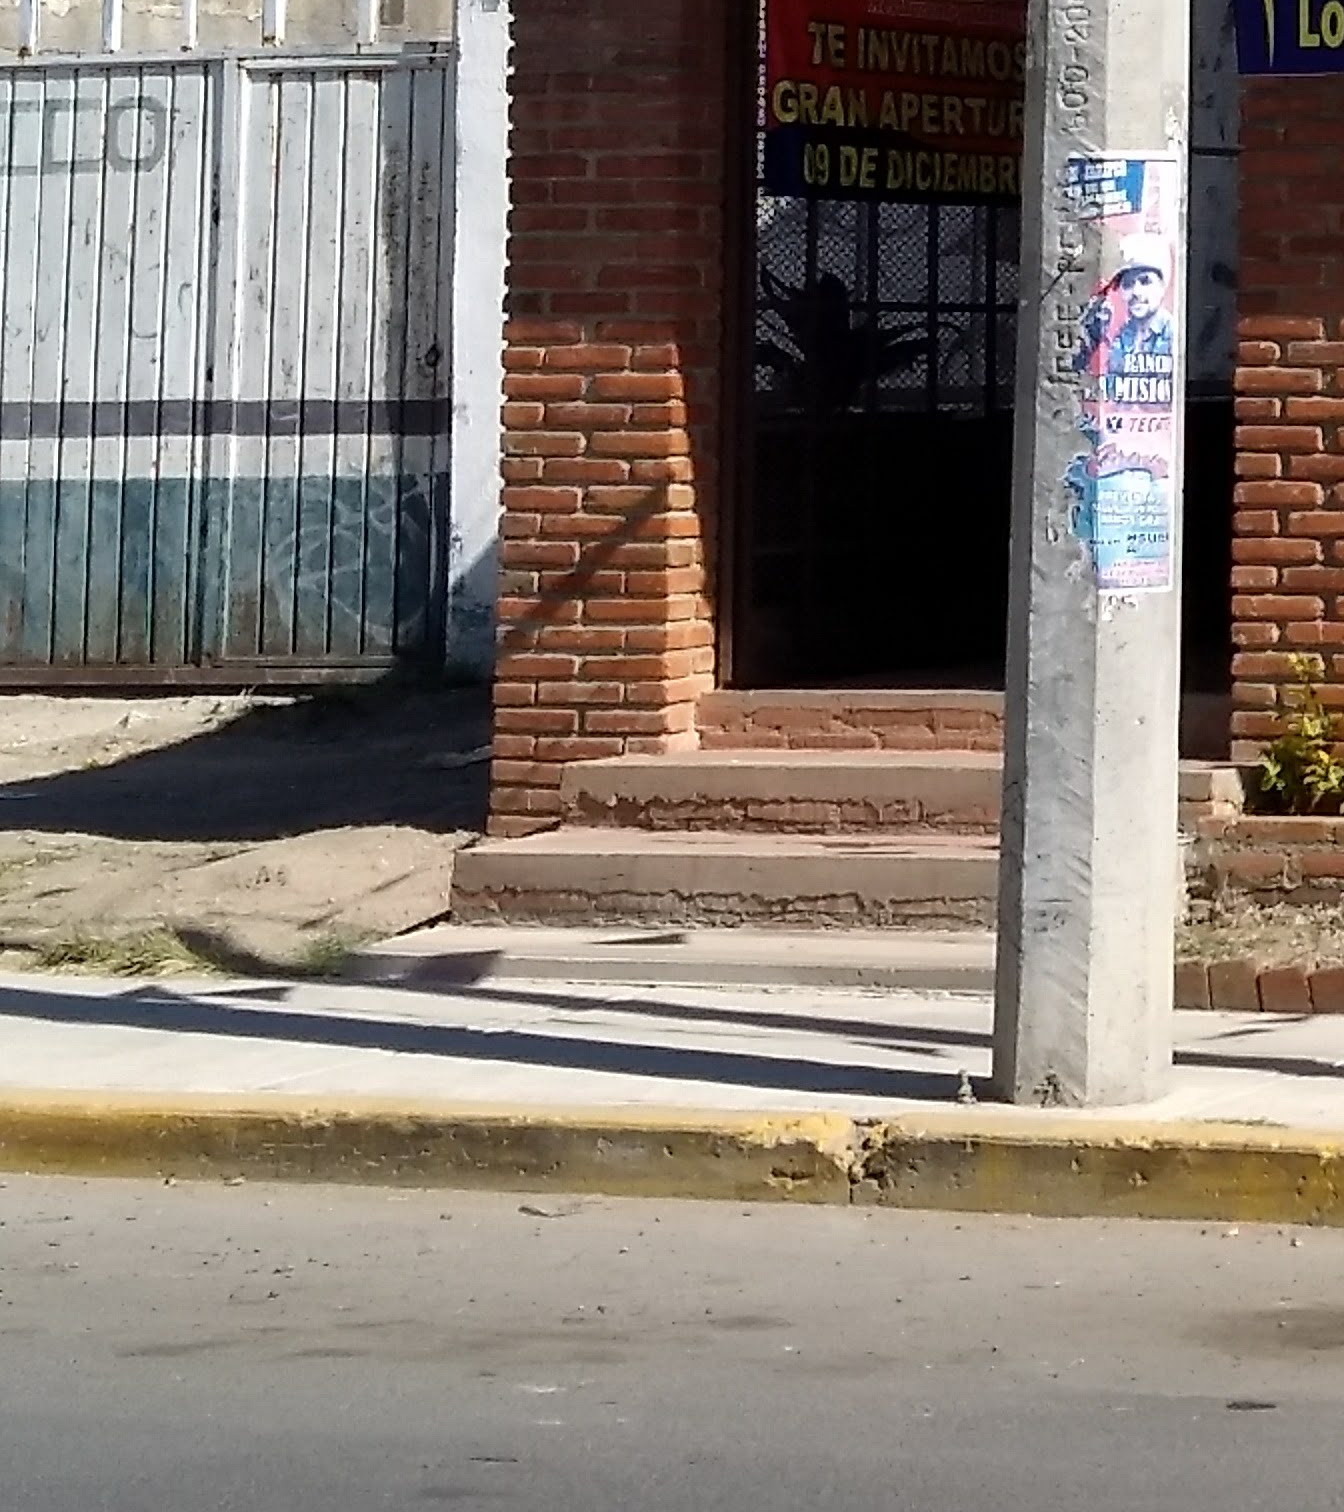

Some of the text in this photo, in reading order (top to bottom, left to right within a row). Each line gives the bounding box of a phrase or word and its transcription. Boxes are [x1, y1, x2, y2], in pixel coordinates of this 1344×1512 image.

[807, 20, 846, 68] TE
[772, 79, 868, 128] GRAN
[839, 145, 879, 189] DE
